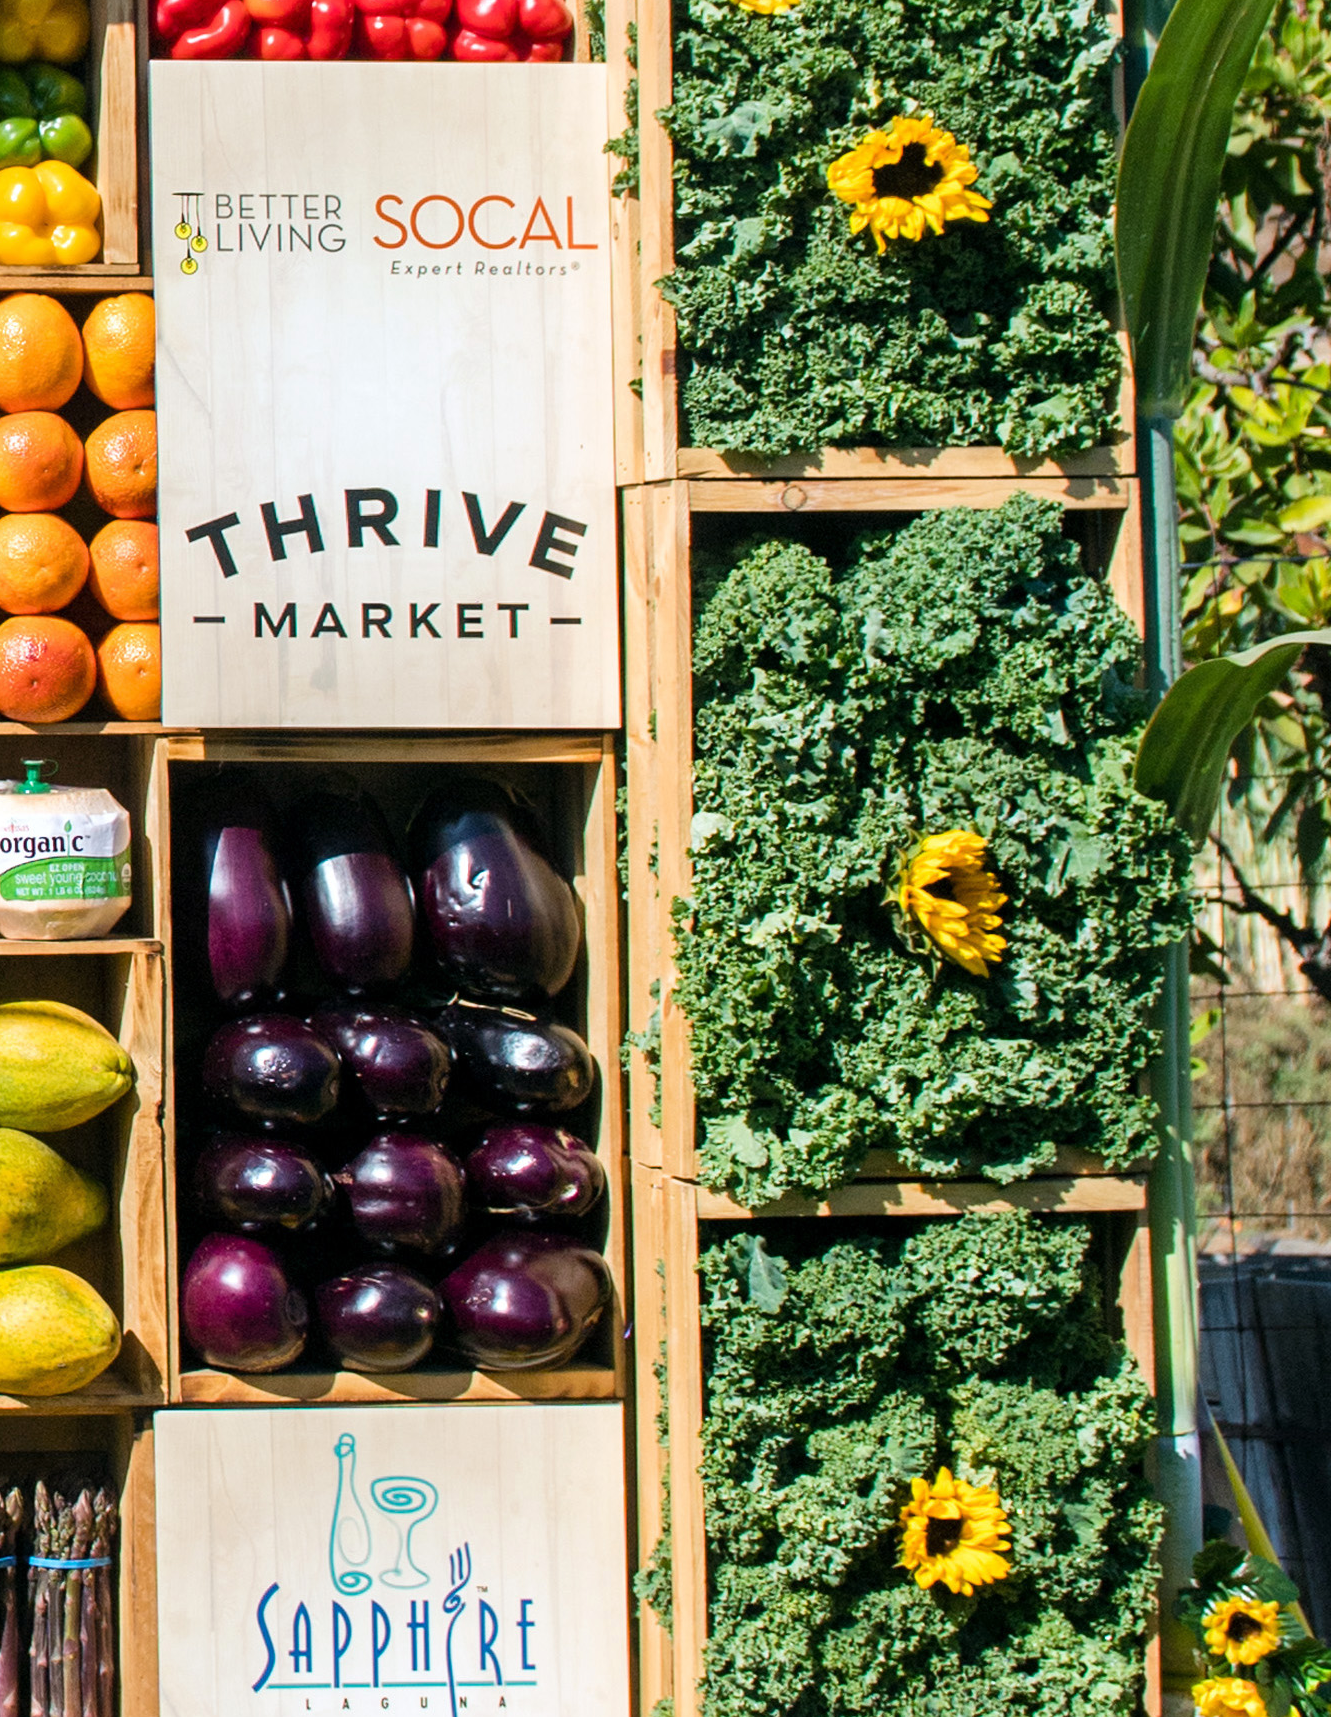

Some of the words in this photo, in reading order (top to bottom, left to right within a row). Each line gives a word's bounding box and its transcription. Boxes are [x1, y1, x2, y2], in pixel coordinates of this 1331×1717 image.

[215, 193, 342, 220] BETTER
[372, 194, 599, 251] SOCAL
[216, 223, 347, 253] LIVING
[390, 260, 464, 279] Expert
[185, 488, 588, 580] THRIVE
[15, 873, 47, 885] sweet
[50, 872, 83, 887] young
[61, 862, 84, 872] OPEN
[253, 1570, 537, 1706] SAPPHIRE
[305, 1697, 507, 1710] LAGUNA
